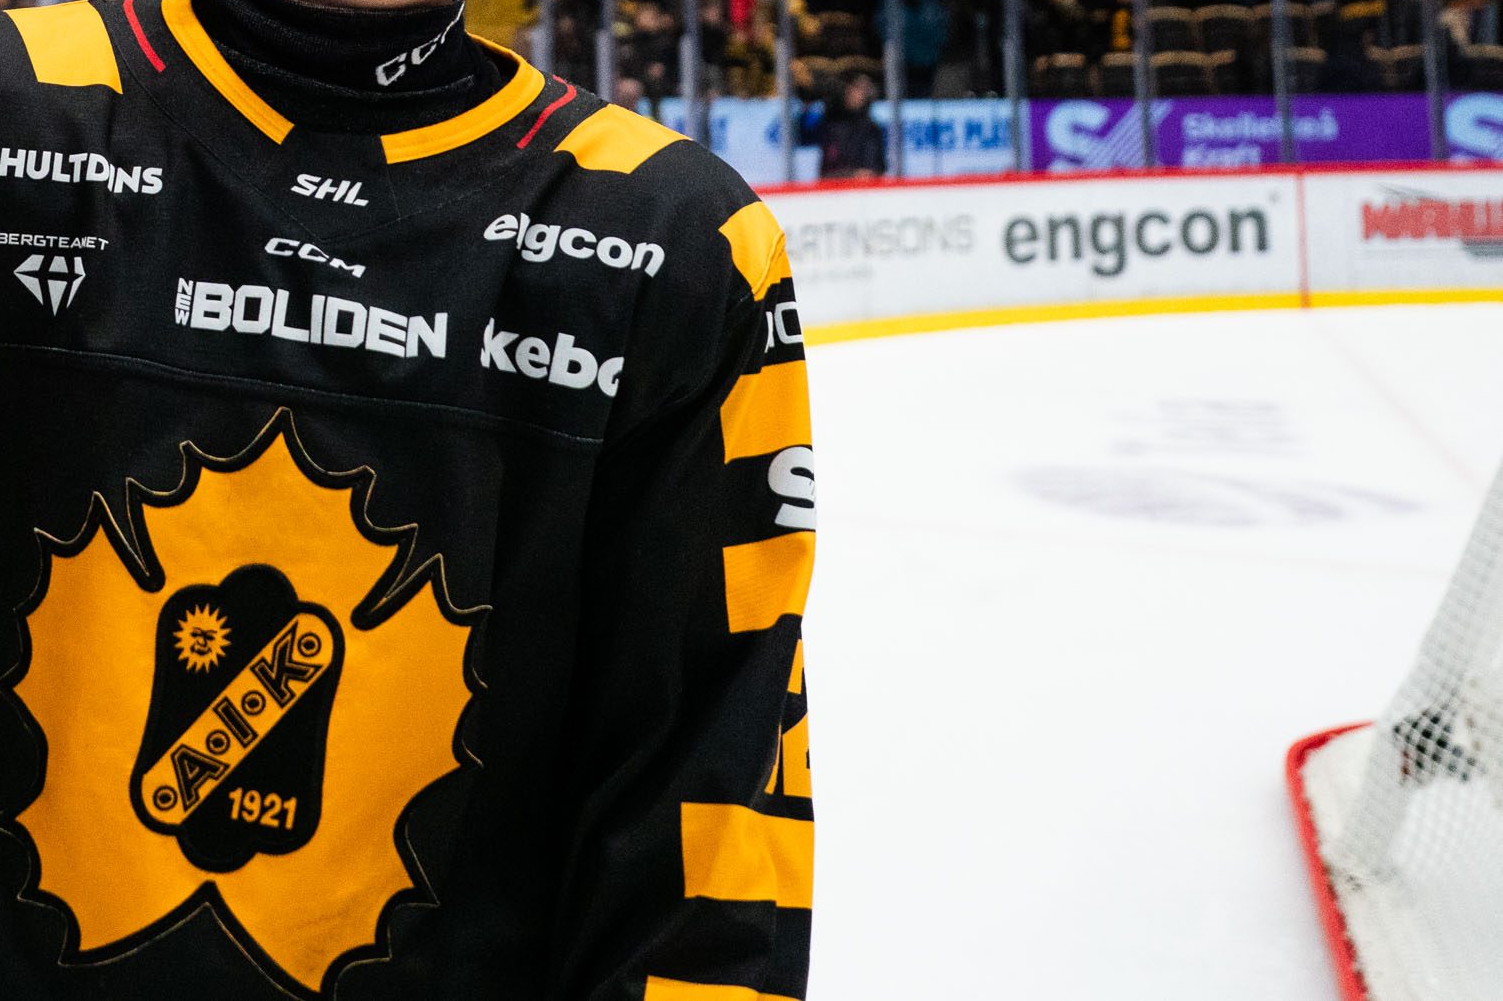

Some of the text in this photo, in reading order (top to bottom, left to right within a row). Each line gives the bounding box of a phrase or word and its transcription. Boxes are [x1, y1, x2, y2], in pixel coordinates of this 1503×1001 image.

[290, 173, 369, 207] SHL
[264, 237, 367, 279] CCM
[1004, 202, 1269, 278] engcon
[190, 281, 449, 359] BOLIDEN
[228, 787, 299, 830] 1921
